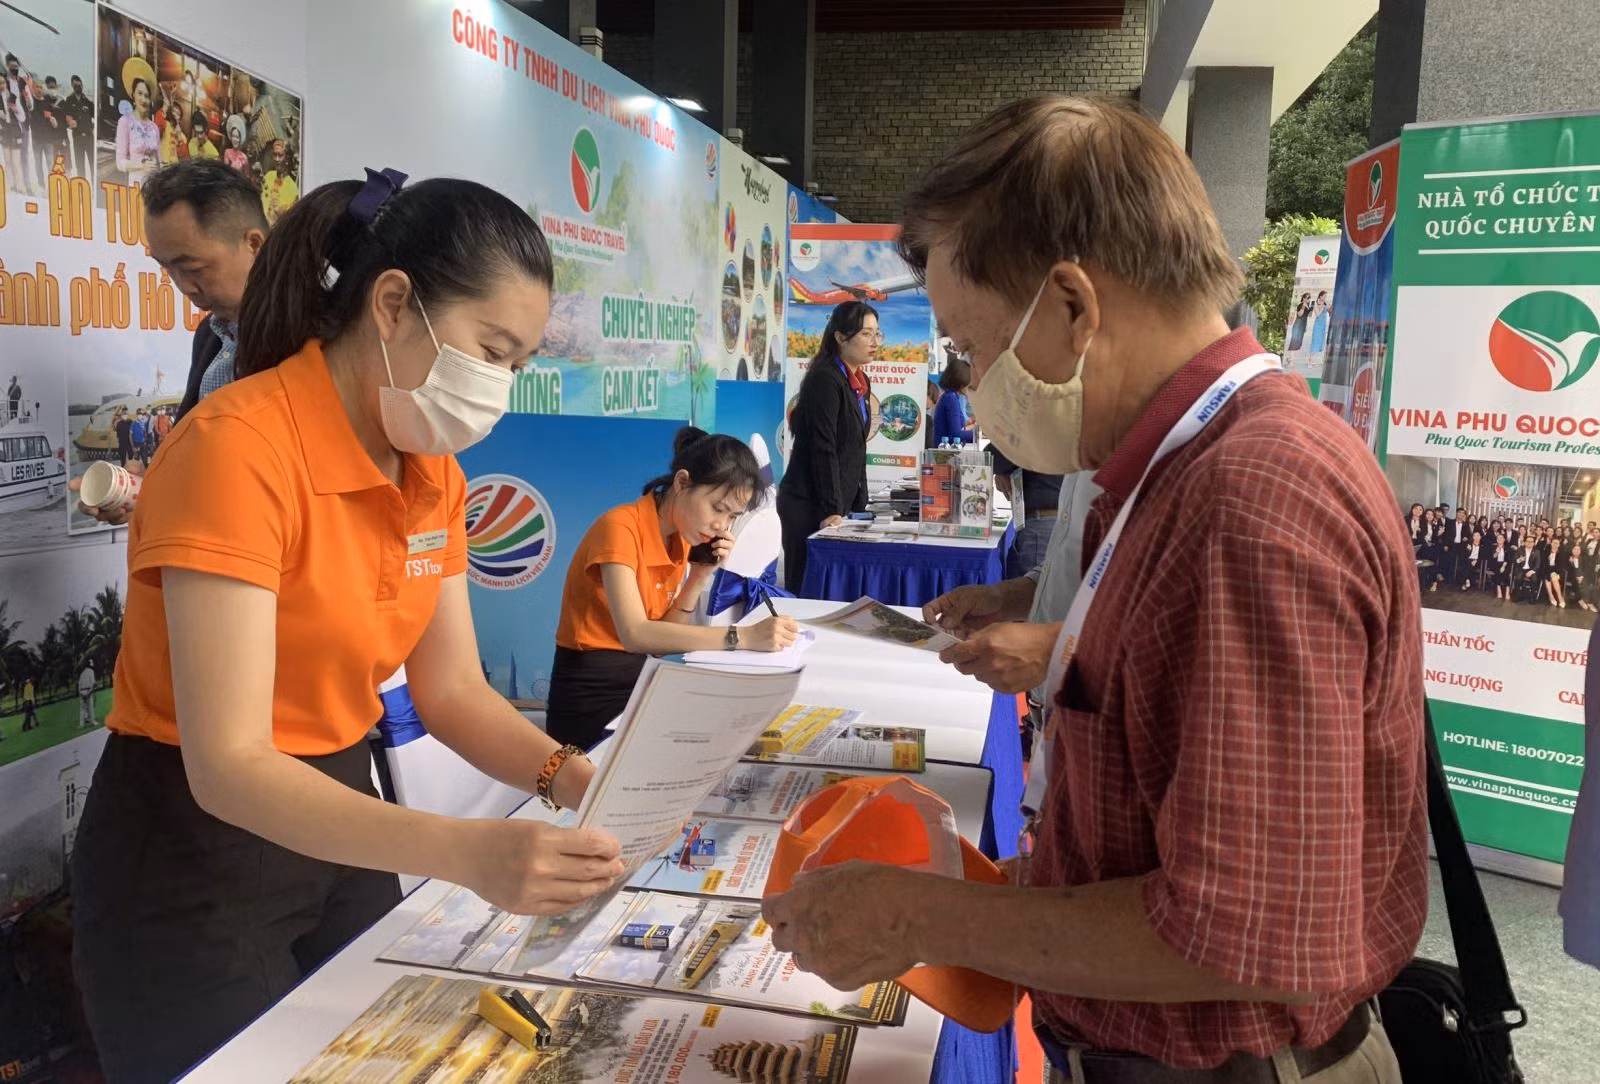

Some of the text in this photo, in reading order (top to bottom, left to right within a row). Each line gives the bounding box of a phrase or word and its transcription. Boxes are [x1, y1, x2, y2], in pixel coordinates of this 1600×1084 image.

[452, 8, 498, 62] CÔNG
[502, 36, 519, 73] TY
[523, 47, 558, 91] TNHH
[562, 68, 578, 102] DU
[581, 78, 606, 115] LỊCH
[48, 155, 93, 240] ẤN
[1417, 185, 1464, 209] NHÀ
[1474, 182, 1505, 208] TỔ
[1512, 181, 1579, 205] CHỨC
[541, 216, 562, 237] VINA
[563, 221, 579, 241] PHU
[580, 226, 602, 246] QUOC
[603, 232, 625, 251] TRAVEL
[1425, 210, 1597, 240] QUỐC CHUYÊN
[70, 262, 130, 336] phố
[138, 267, 175, 331] Hồ
[601, 292, 654, 340] CHUYÊN
[602, 369, 634, 412] CAM
[637, 355, 660, 408] KẾT
[886, 376, 906, 385] BAY
[1196, 381, 1237, 423] FAMSUN
[1355, 390, 1370, 409] SIÊ
[1390, 407, 1448, 429] VINA
[1456, 411, 1507, 432] PHU
[1516, 414, 1600, 437] QUOC
[1424, 432, 1452, 447] Phu
[1454, 434, 1489, 450] Quoc
[1492, 436, 1551, 453] Tourism
[11, 462, 45, 480] LES RIVES
[872, 457, 896, 465] COMBO
[504, 579, 515, 588] DU
[543, 544, 553, 563] NAM
[1463, 634, 1495, 653] TỐC
[1424, 668, 1503, 693] NG LƯỢNG
[1443, 731, 1585, 767] HOTLINE: 18007022
